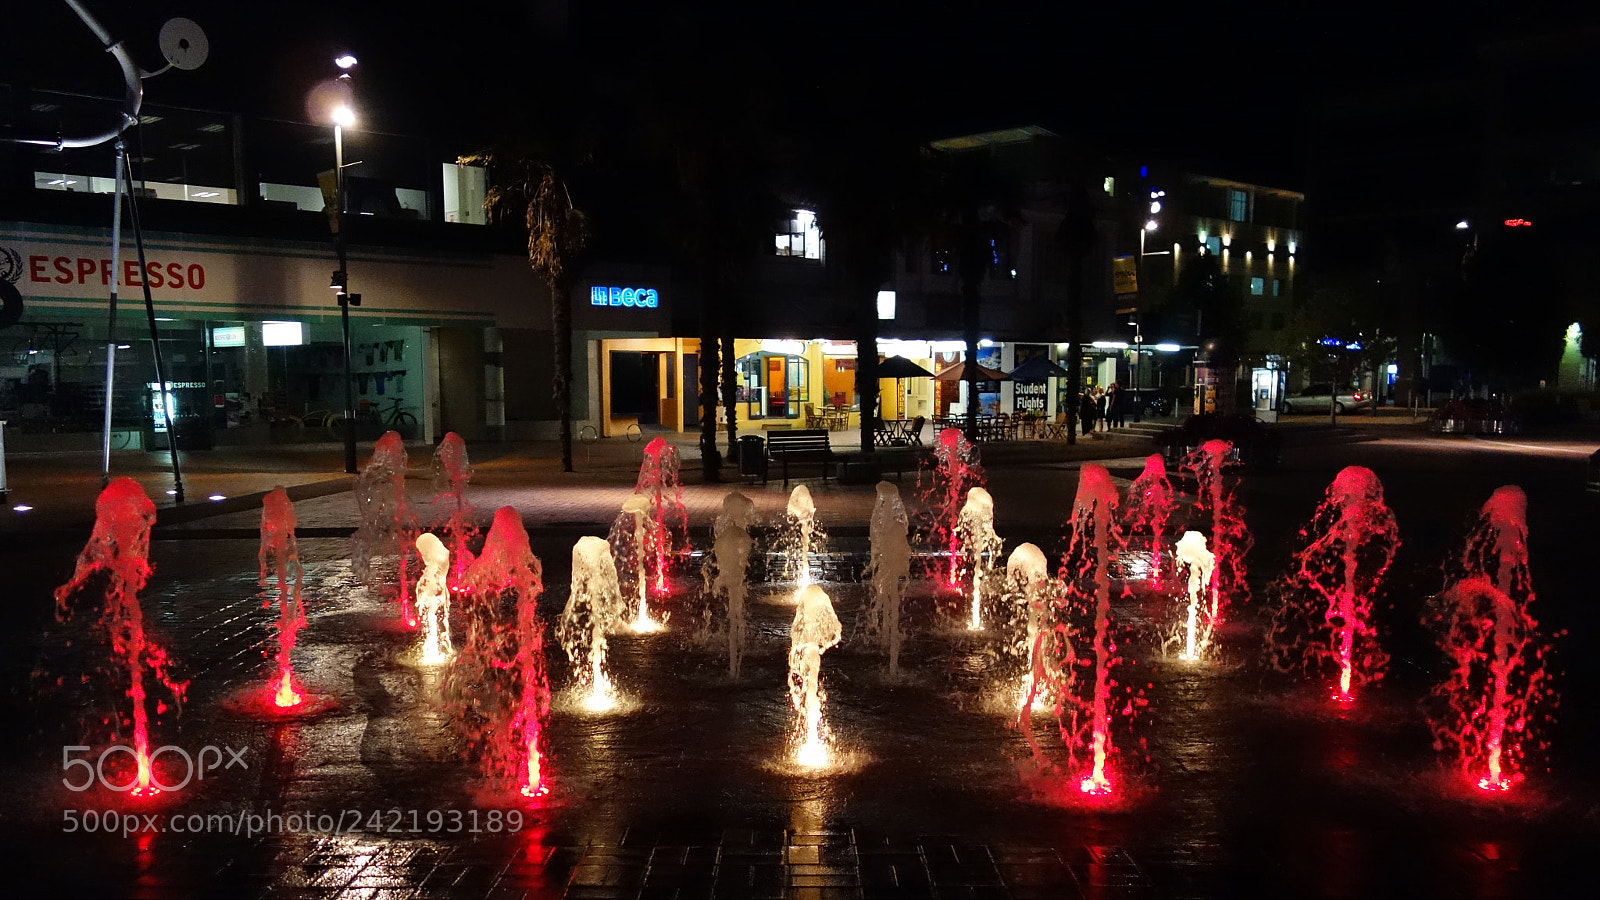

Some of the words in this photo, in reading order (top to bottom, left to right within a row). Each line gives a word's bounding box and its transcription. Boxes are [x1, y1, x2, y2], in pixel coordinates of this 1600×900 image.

[29, 255, 206, 290] ESPRESSO
[608, 286, 658, 308] Beca
[1015, 382, 1047, 395] Student
[1016, 396, 1044, 410] Flights
